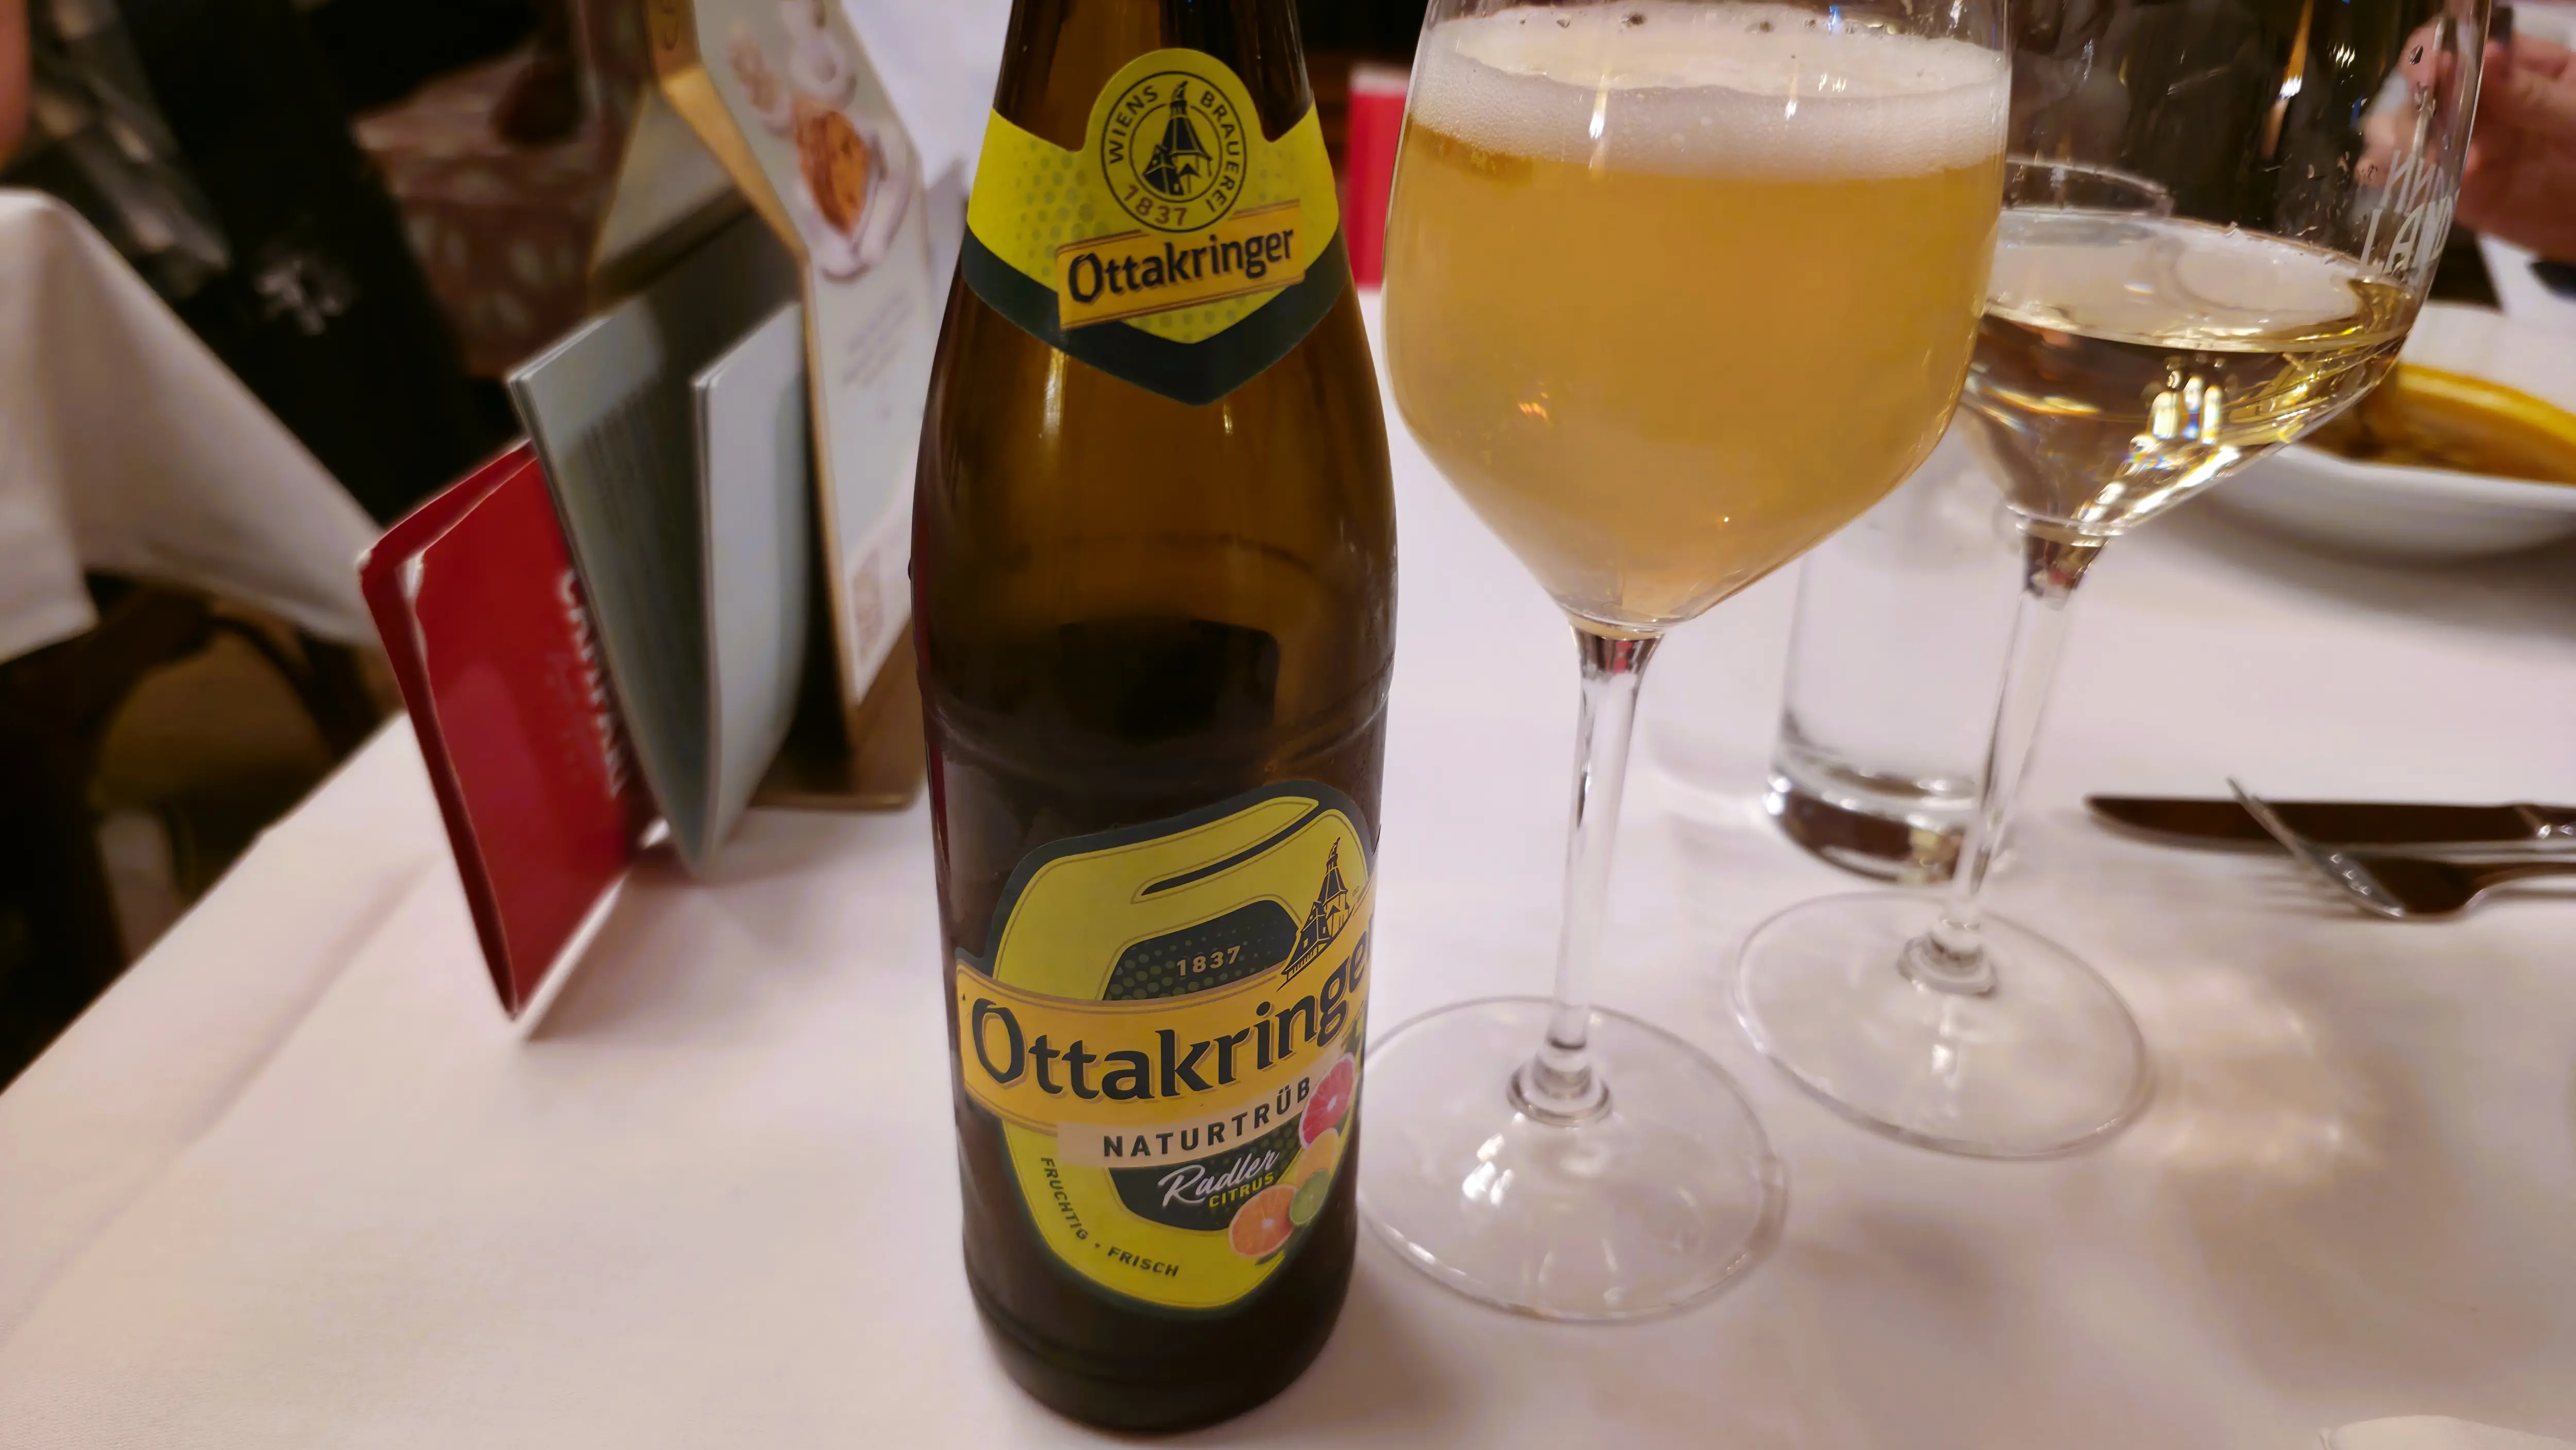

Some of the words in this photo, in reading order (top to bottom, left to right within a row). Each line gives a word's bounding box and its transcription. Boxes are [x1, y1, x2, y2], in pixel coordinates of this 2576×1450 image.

[1110, 84, 1158, 164] WIENS
[1200, 91, 1240, 213] BRAUEREI
[1124, 186, 1187, 226] 1837
[1068, 228, 1294, 304] Ottakringer
[1177, 945, 1241, 977] 1837
[1104, 1076, 1312, 1158] NATURTRÜB
[1158, 1148, 1280, 1208] Radler
[1209, 1171, 1276, 1209] CITRUS
[1040, 1157, 1088, 1241] FRUCHTIG
[1107, 1245, 1179, 1278] FRISCH
